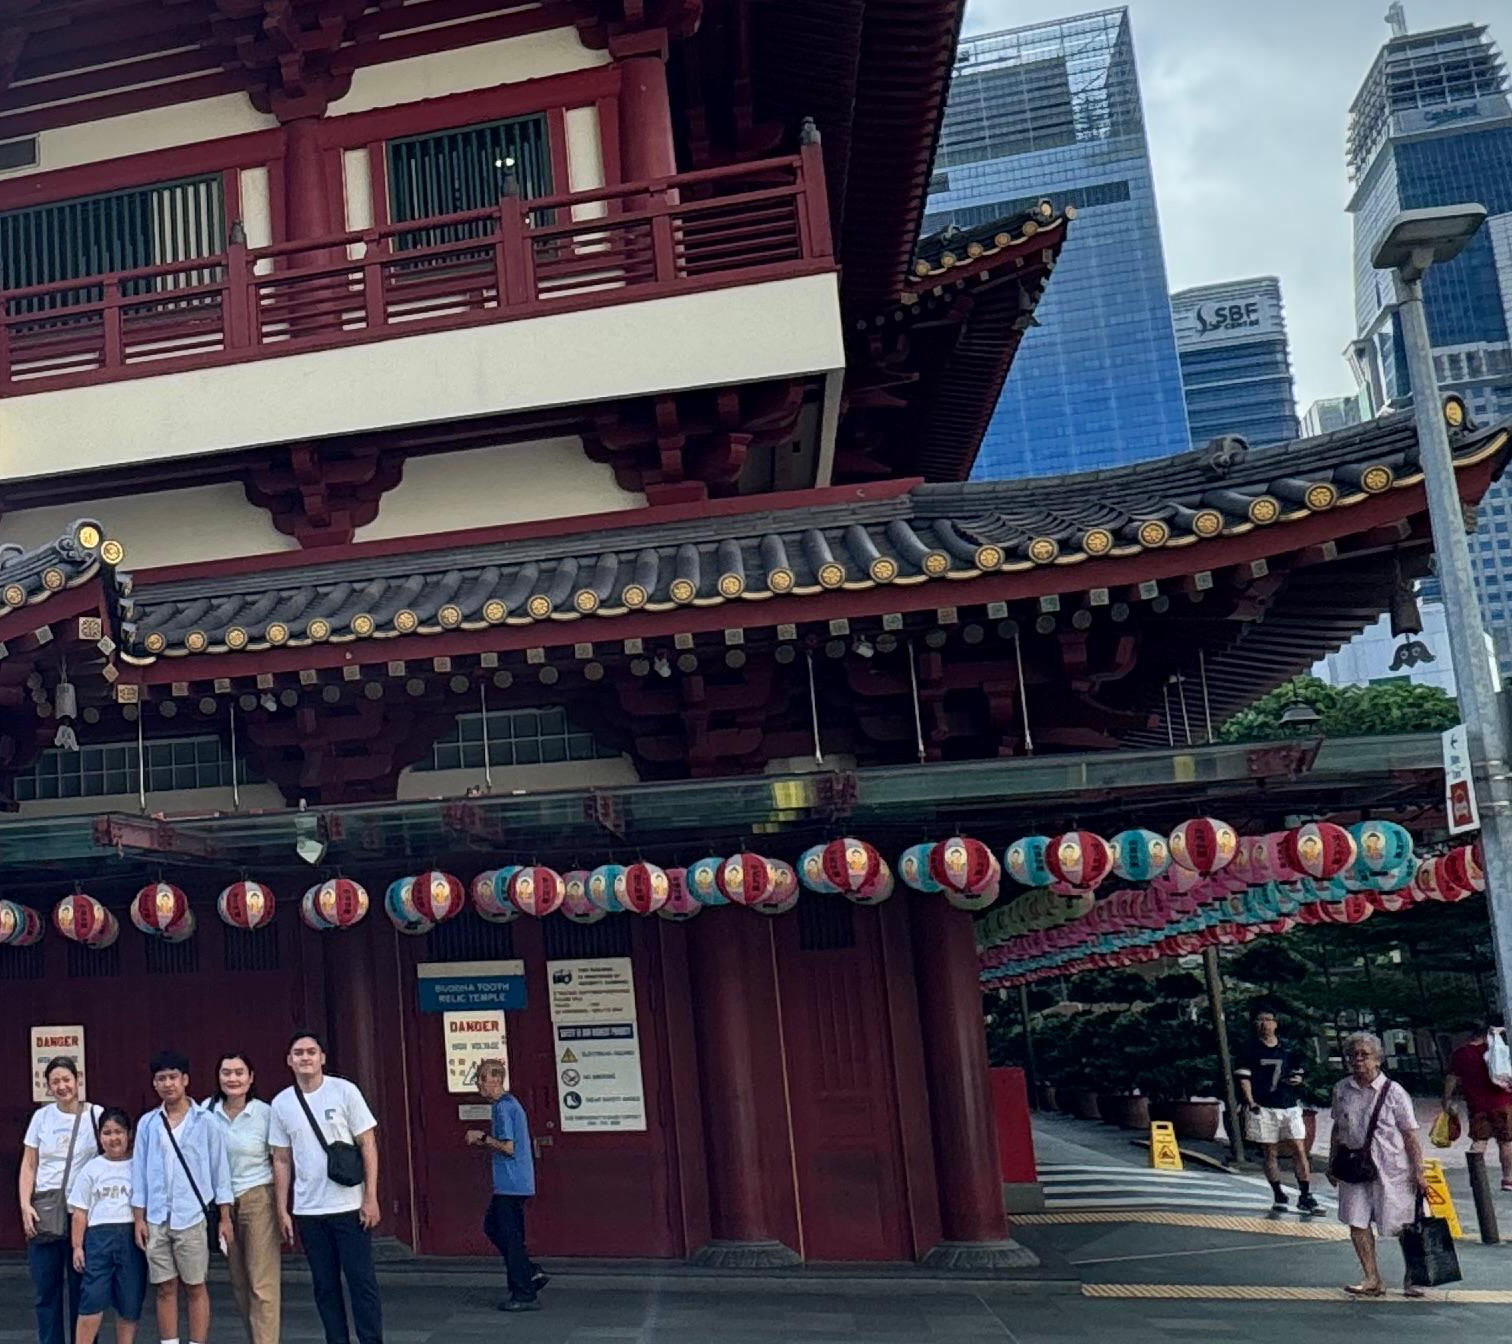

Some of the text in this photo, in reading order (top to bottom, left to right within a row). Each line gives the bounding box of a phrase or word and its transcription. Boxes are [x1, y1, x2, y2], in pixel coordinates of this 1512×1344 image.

[1215, 303, 1258, 324] SBF
[434, 982, 510, 993] BUDDHA TOOTH
[438, 993, 505, 1004] RELIC TEMPLE
[449, 1020, 500, 1033] DANGER
[36, 1035, 79, 1048] DANGER
[1260, 1059, 1283, 1092] 7
